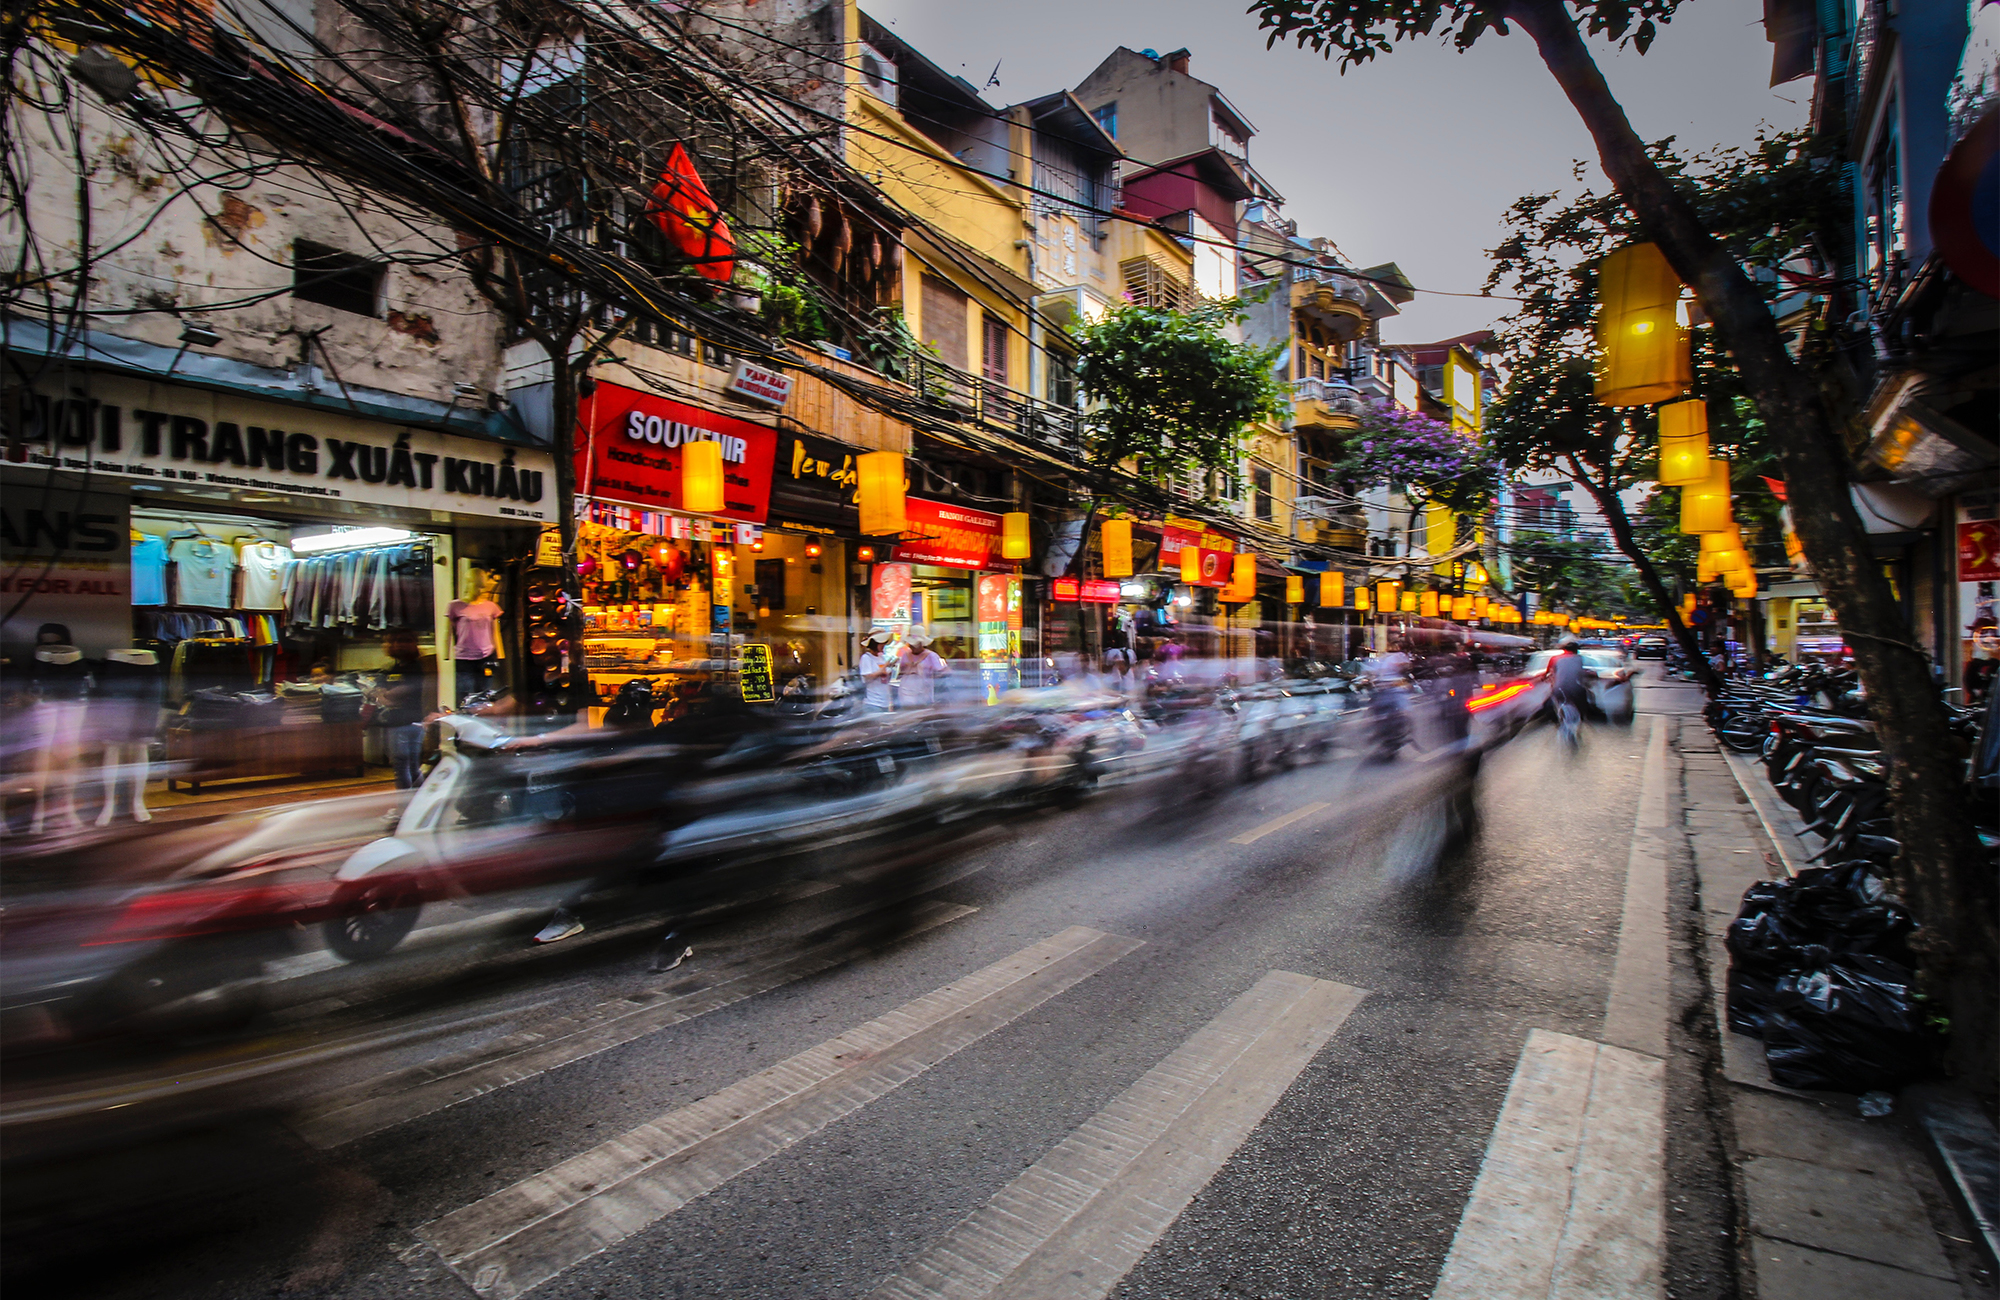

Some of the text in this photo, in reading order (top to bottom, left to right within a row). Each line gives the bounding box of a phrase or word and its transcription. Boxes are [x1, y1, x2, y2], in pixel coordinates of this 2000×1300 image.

[134, 408, 318, 474] TRANG
[325, 432, 438, 489] XUẤT
[444, 448, 543, 503] KHẨU
[938, 510, 997, 528] HANOI GALLERY
[16, 578, 73, 594] FOR
[75, 580, 122, 595] ALL
